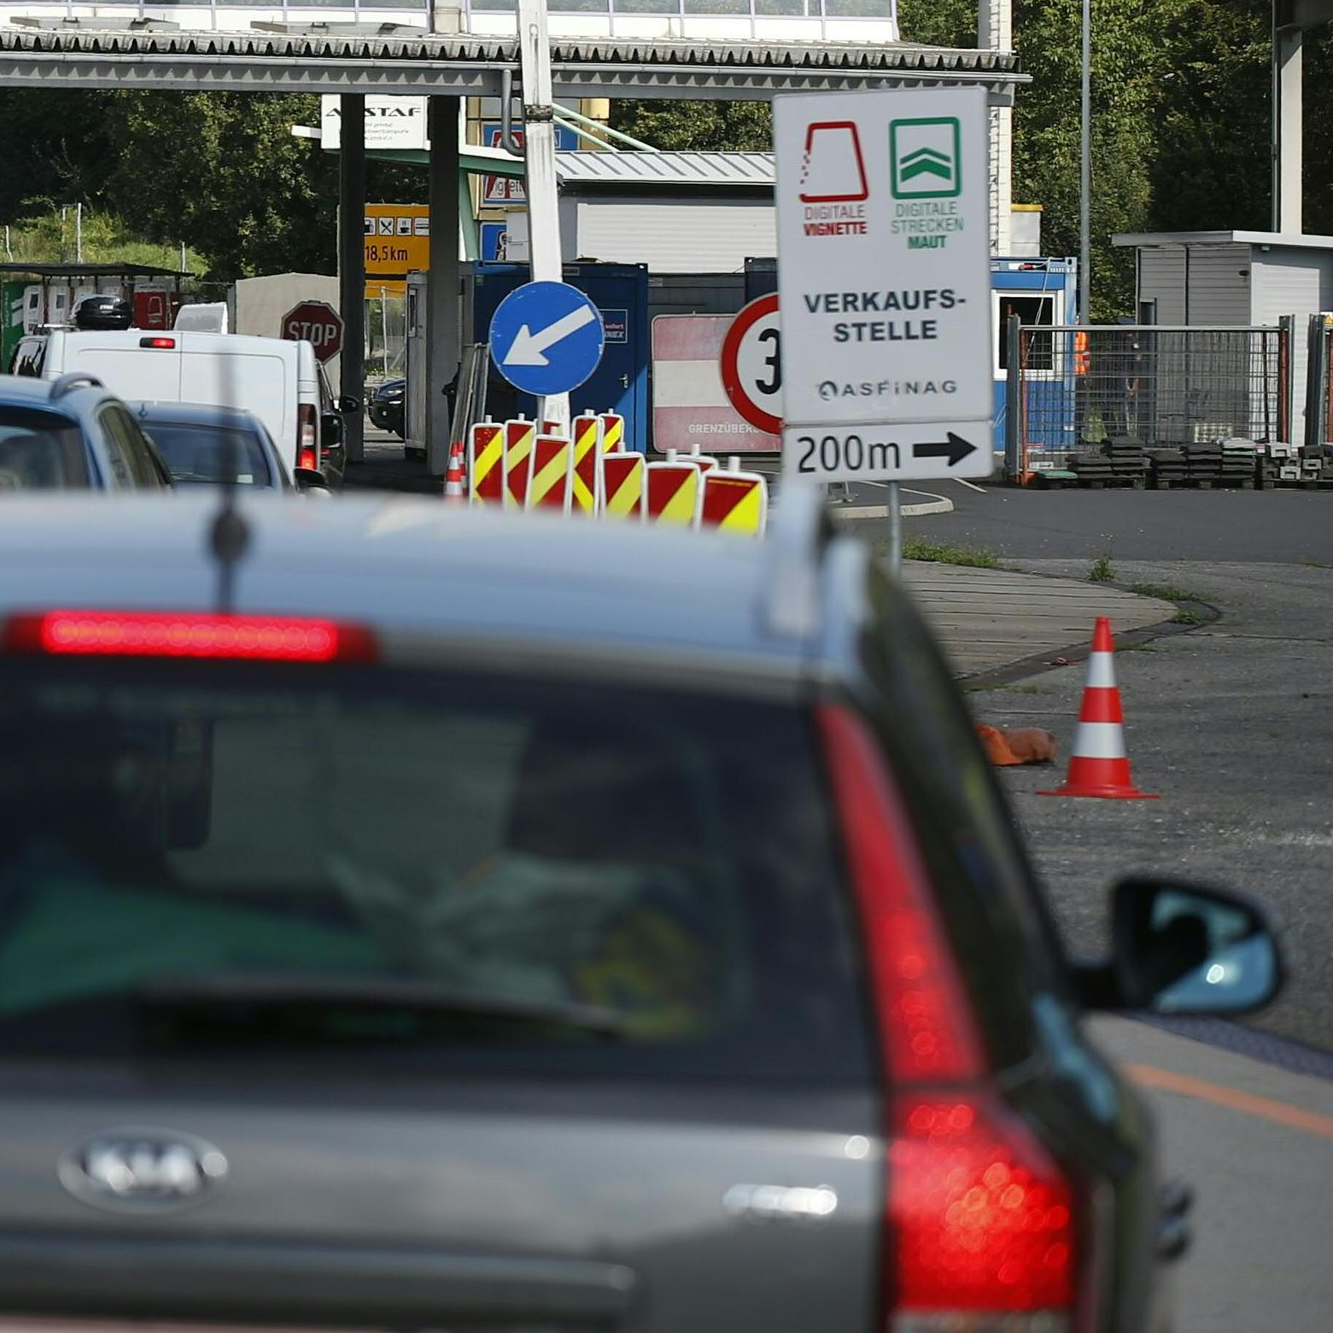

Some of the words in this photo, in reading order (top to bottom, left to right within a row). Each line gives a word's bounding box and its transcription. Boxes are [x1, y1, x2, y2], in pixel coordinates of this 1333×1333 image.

[325, 107, 421, 117] ASTAF
[804, 204, 865, 220] DIGITALE
[896, 202, 957, 218] DIGITALE
[804, 221, 867, 236] VIGNETTE
[891, 216, 964, 234] STRECKEN
[908, 235, 946, 250] MAUT
[390, 246, 408, 261] km
[804, 288, 966, 314] VERKAUFS-
[289, 322, 337, 346] STOP
[833, 320, 937, 342] STELLE
[755, 328, 781, 394] 3
[797, 434, 900, 473] 200m
